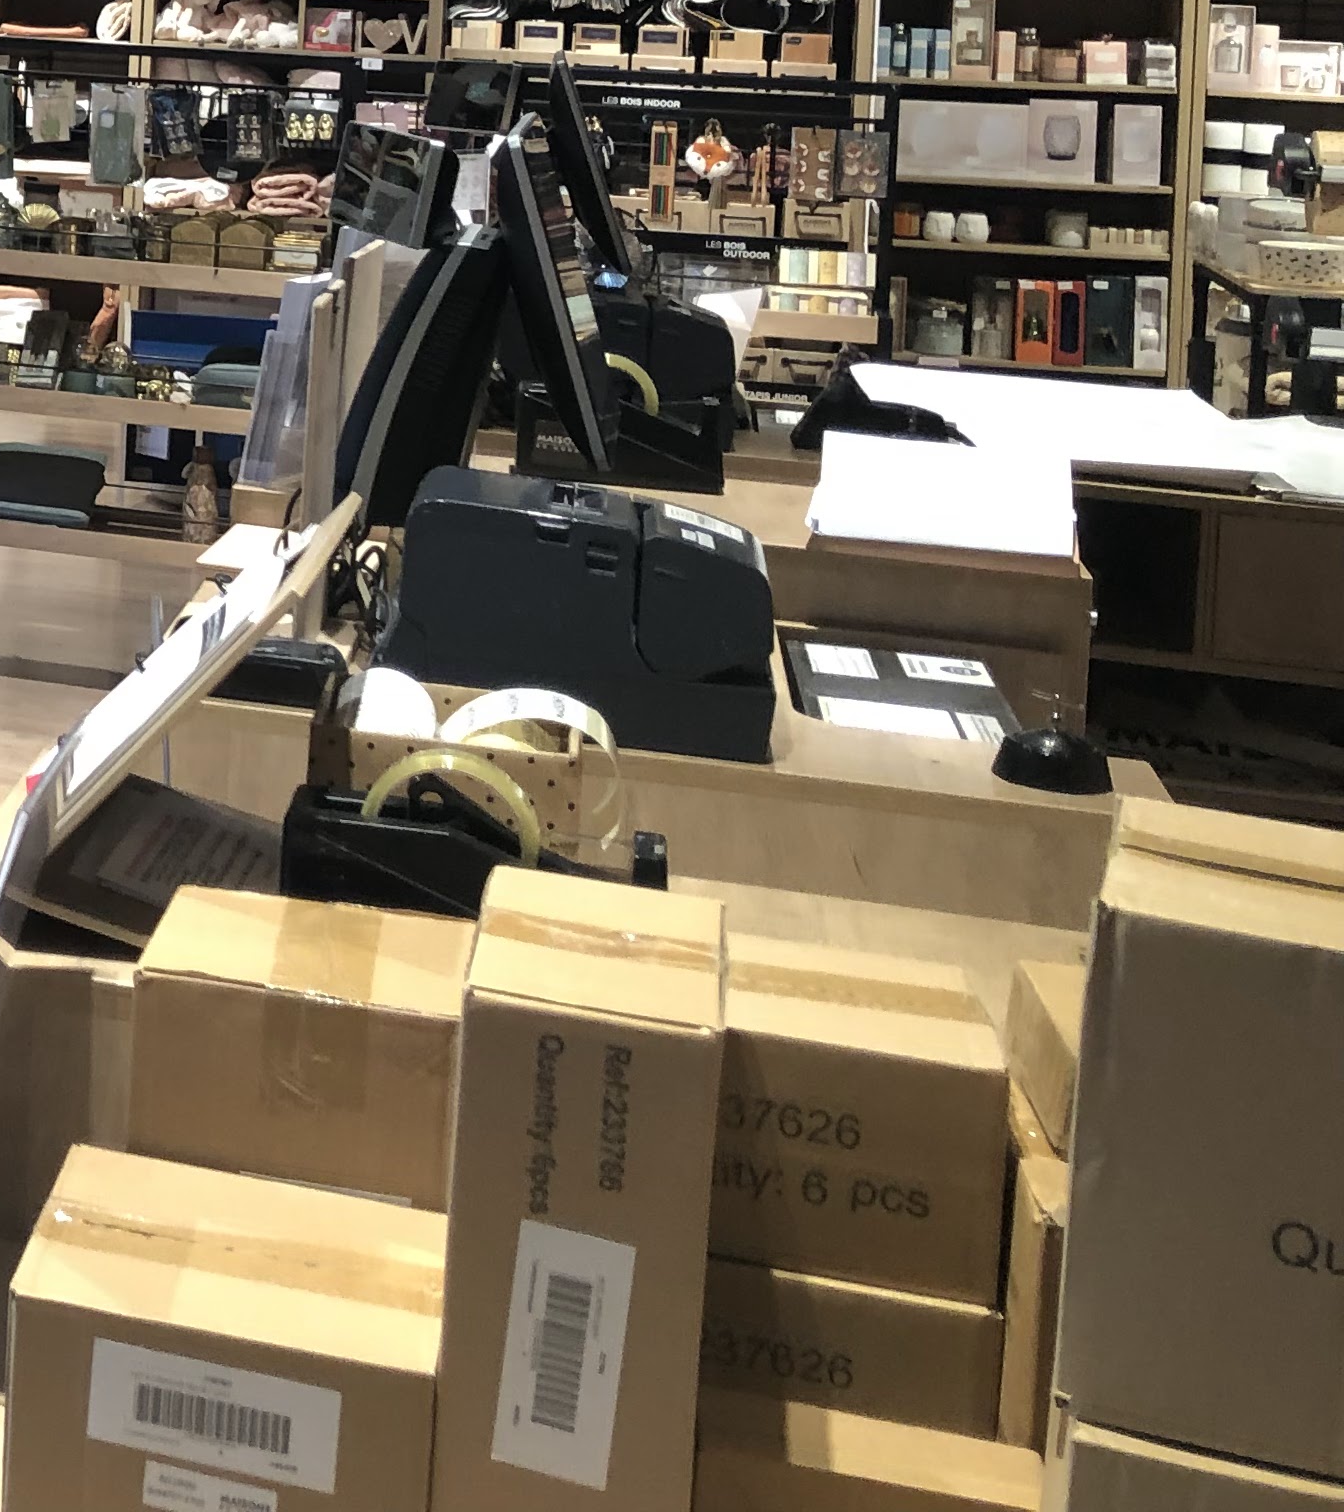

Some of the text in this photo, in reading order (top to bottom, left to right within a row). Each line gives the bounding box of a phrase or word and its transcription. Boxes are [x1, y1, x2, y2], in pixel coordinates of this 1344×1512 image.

[602, 96, 681, 108] LES BOIS INDOOR
[705, 241, 746, 250] LES BOIS
[723, 250, 771, 260] OUTDOOR
[745, 390, 808, 403] TAPIS JUNIOR
[720, 1093, 862, 1151] 37626
[712, 1154, 931, 1220] ity: 6 pcs
